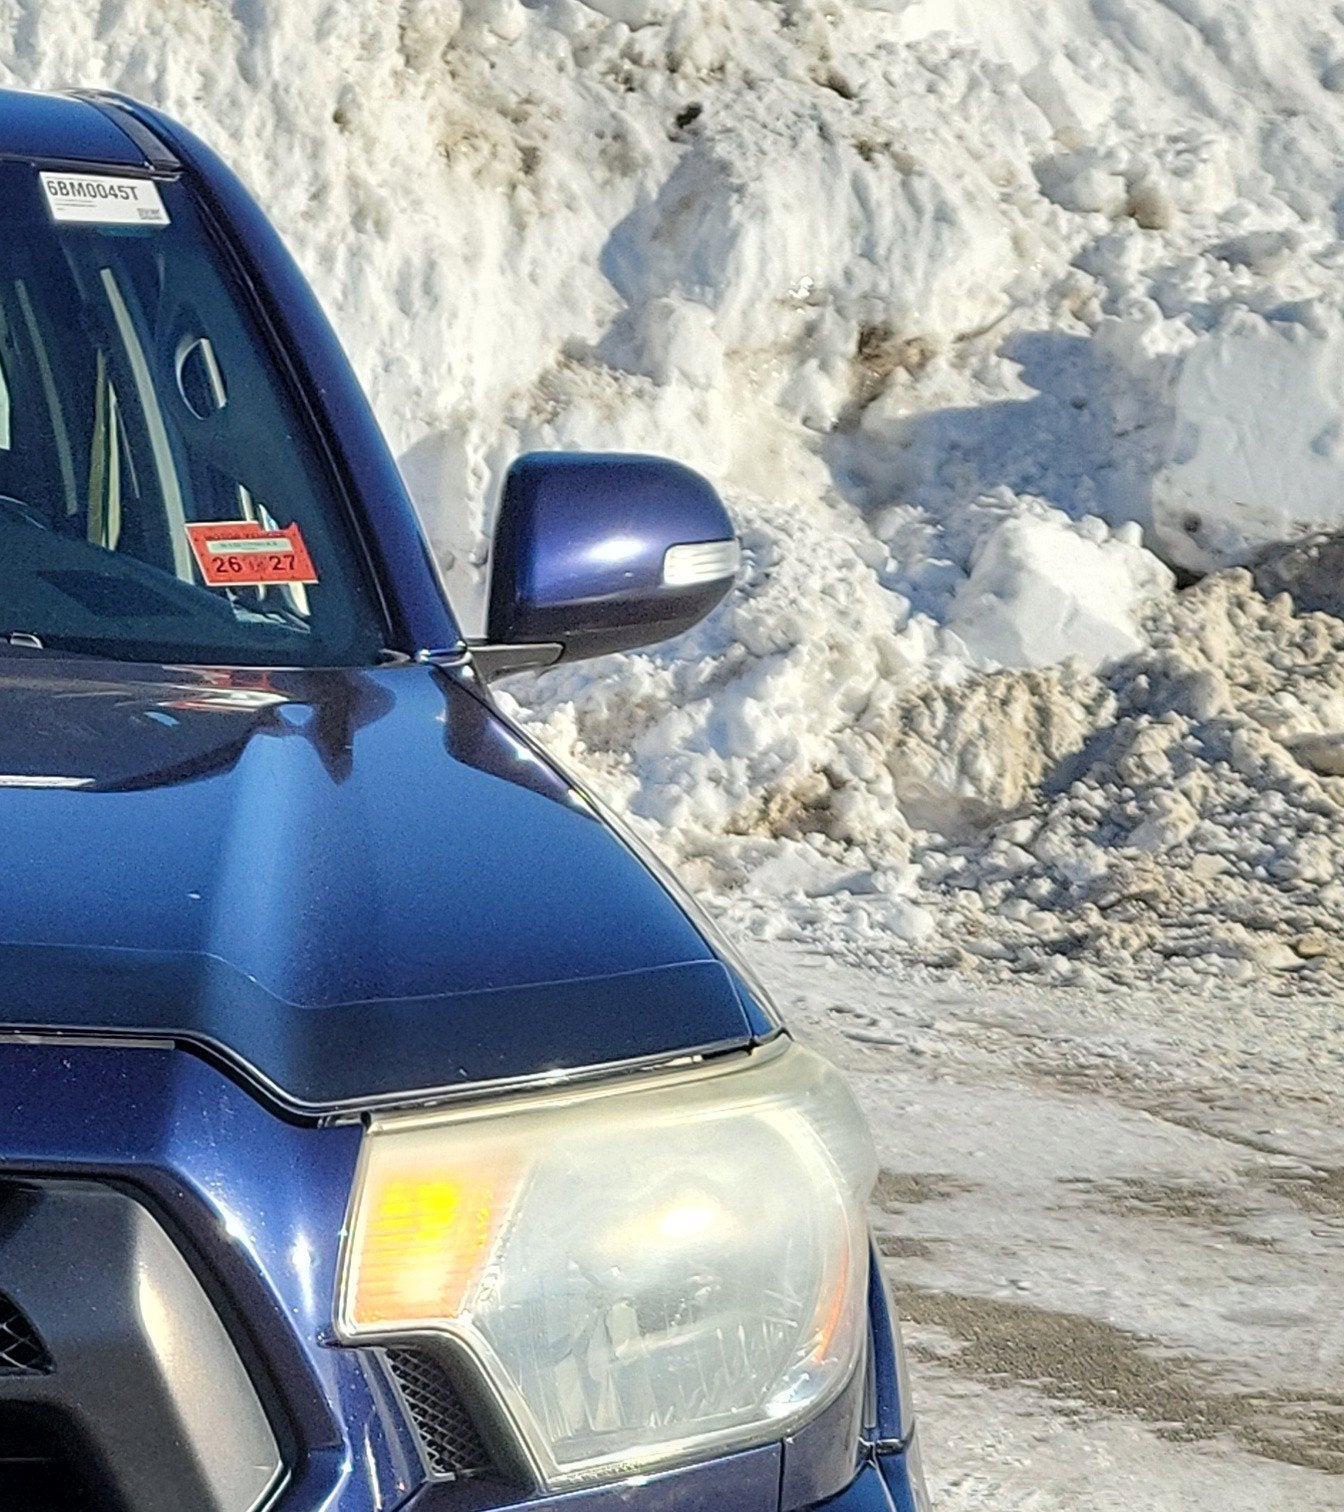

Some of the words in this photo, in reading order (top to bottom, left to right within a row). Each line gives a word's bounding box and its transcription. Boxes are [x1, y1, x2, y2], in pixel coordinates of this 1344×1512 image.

[47, 180, 139, 200] 6BM0045T
[212, 556, 243, 573] 26
[269, 554, 295, 571] 27
